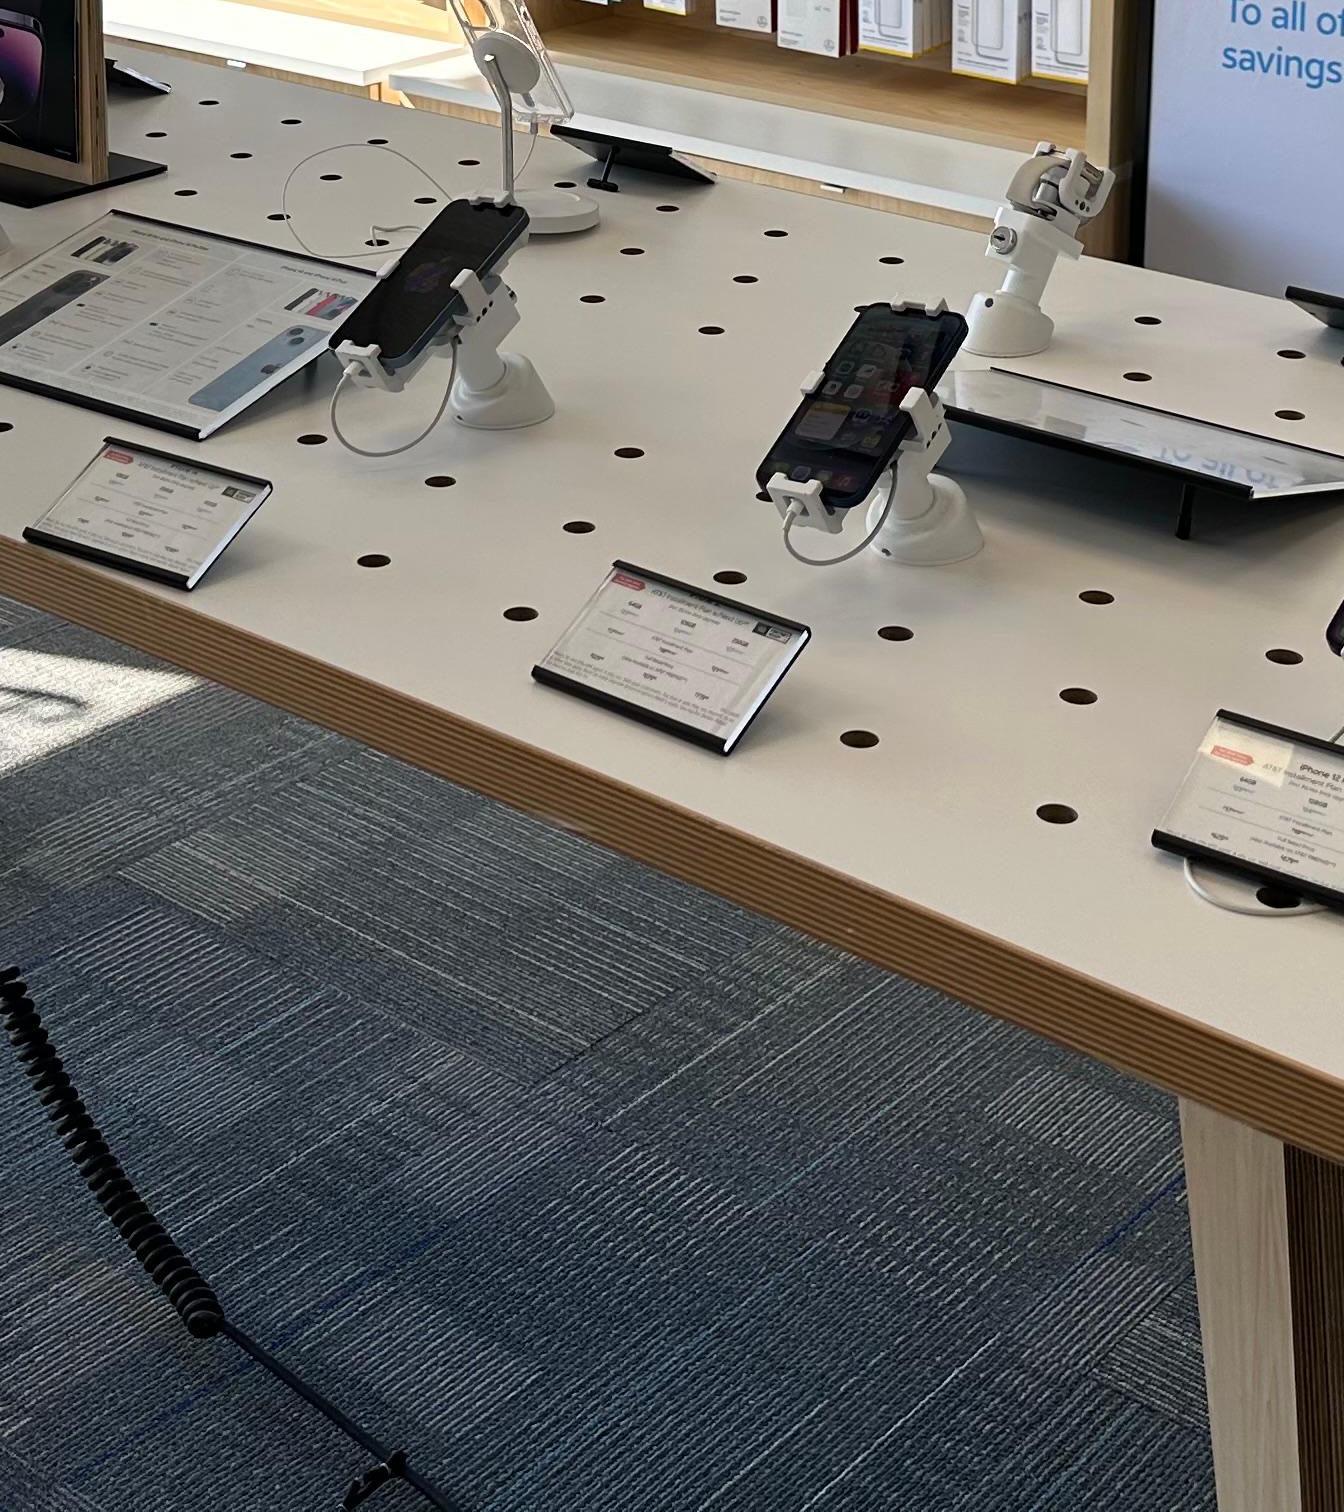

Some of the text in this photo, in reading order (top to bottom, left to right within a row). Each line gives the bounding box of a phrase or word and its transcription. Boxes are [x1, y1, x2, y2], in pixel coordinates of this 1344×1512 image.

[1270, 0, 1307, 33] all
[1221, 45, 1344, 90] savings
[1299, 763, 1330, 780] iPhone
[1331, 772, 1342, 783] 12
